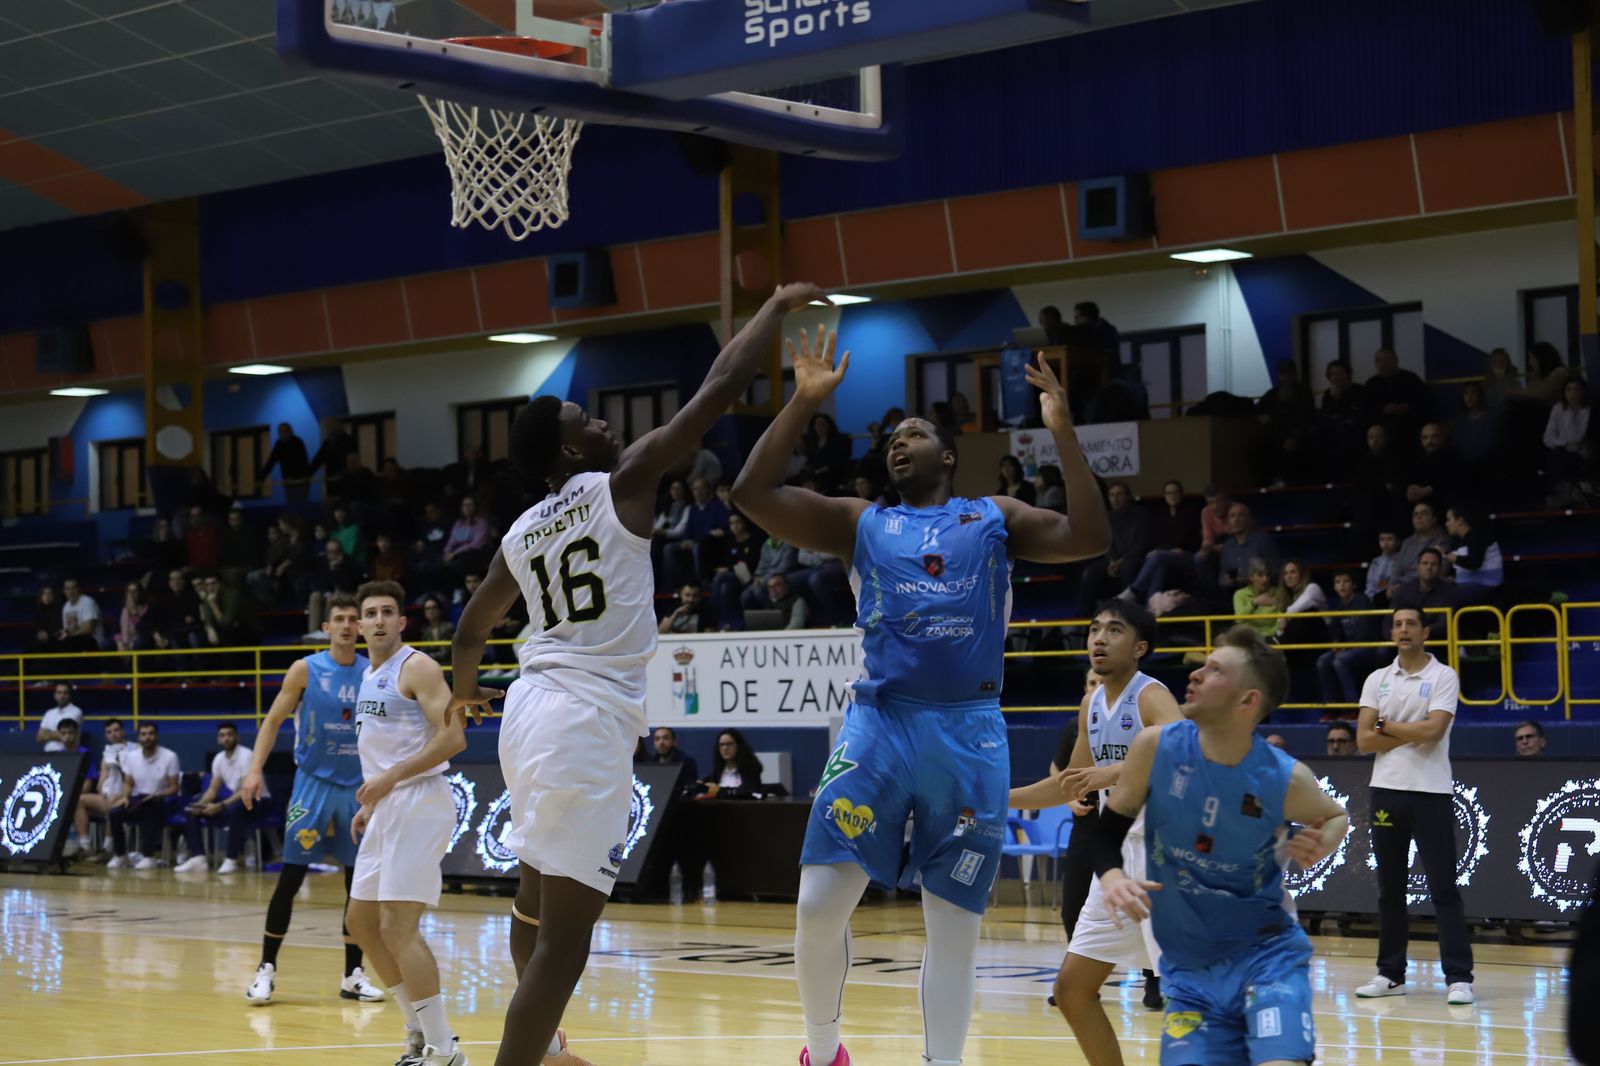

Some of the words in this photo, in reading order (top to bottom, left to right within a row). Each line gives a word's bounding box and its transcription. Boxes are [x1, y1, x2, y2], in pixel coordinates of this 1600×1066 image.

[744, 1, 872, 48] Sports
[530, 536, 607, 632] 16
[895, 575, 979, 594] INNOVACHEF
[926, 626, 975, 638] ZAMORA
[720, 643, 856, 668] AYUNTAMI
[337, 685, 356, 703] 44
[720, 680, 759, 713] DE
[825, 805, 877, 834] ZAMORA
[1201, 796, 1220, 828] 9
